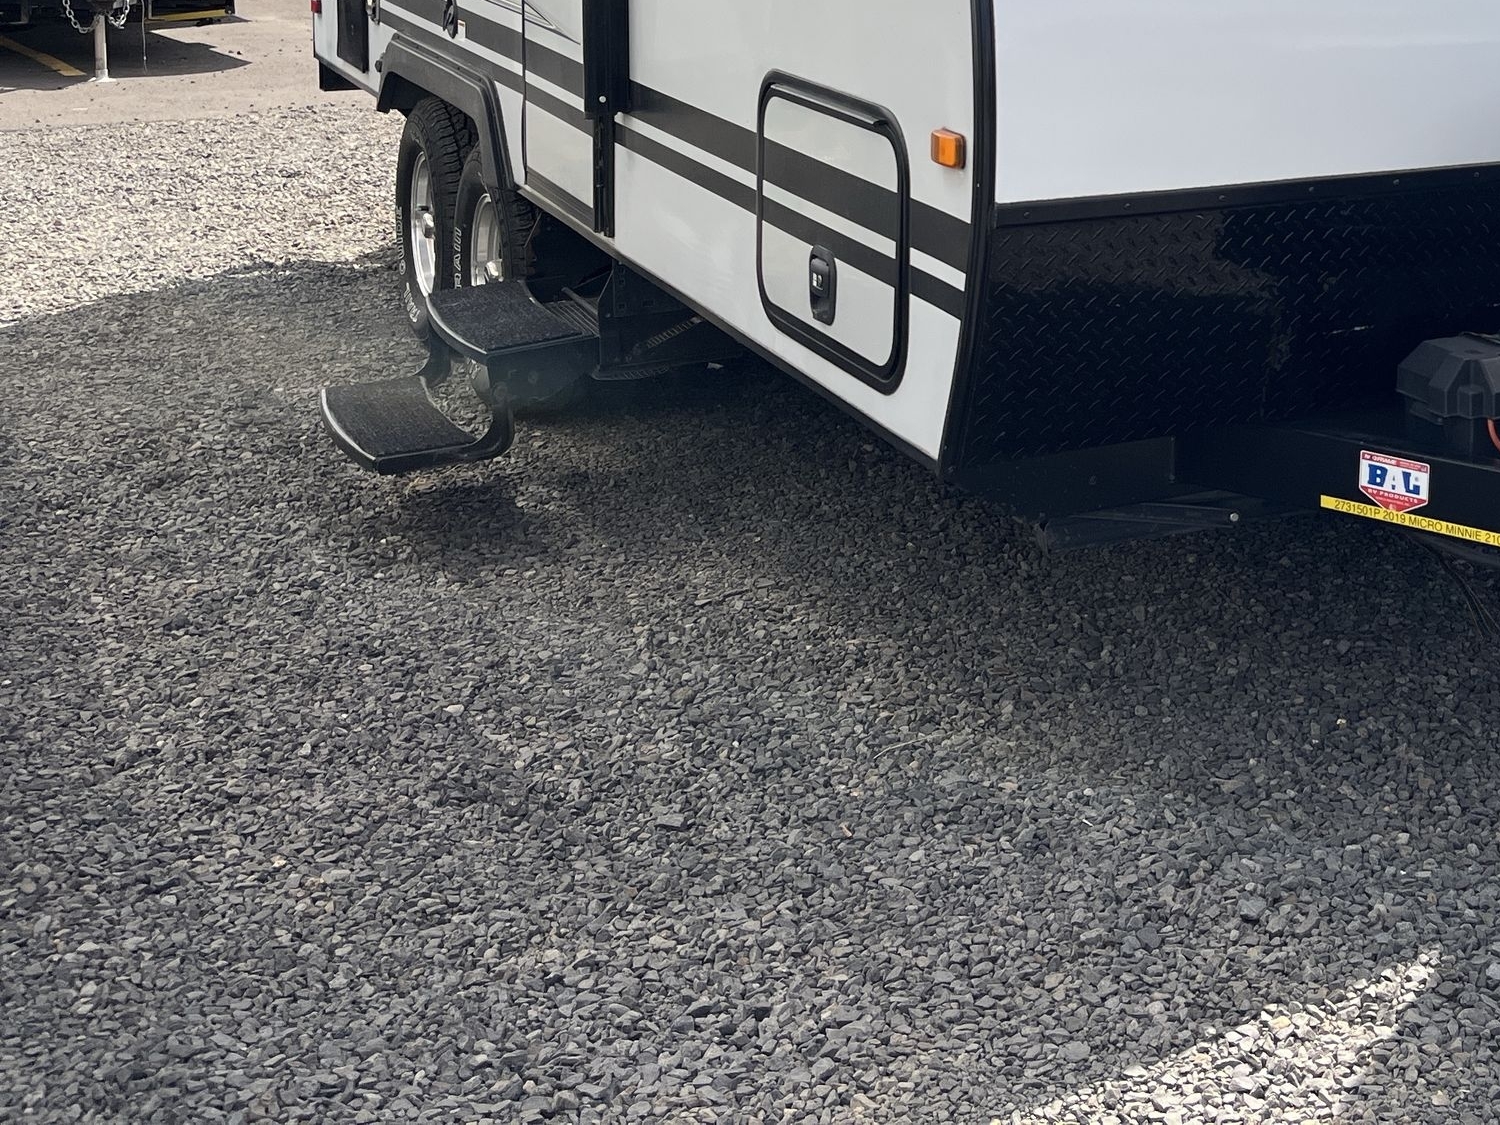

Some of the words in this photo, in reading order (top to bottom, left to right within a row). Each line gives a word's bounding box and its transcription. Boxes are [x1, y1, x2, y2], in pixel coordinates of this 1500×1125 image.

[1368, 463, 1421, 496] BAL
[1379, 490, 1418, 504] PRODUCTS
[1334, 499, 1381, 517] 2731501P
[1383, 510, 1406, 524] 2019
[1408, 515, 1443, 532] MICRO
[1445, 524, 1482, 540] MINNIE
